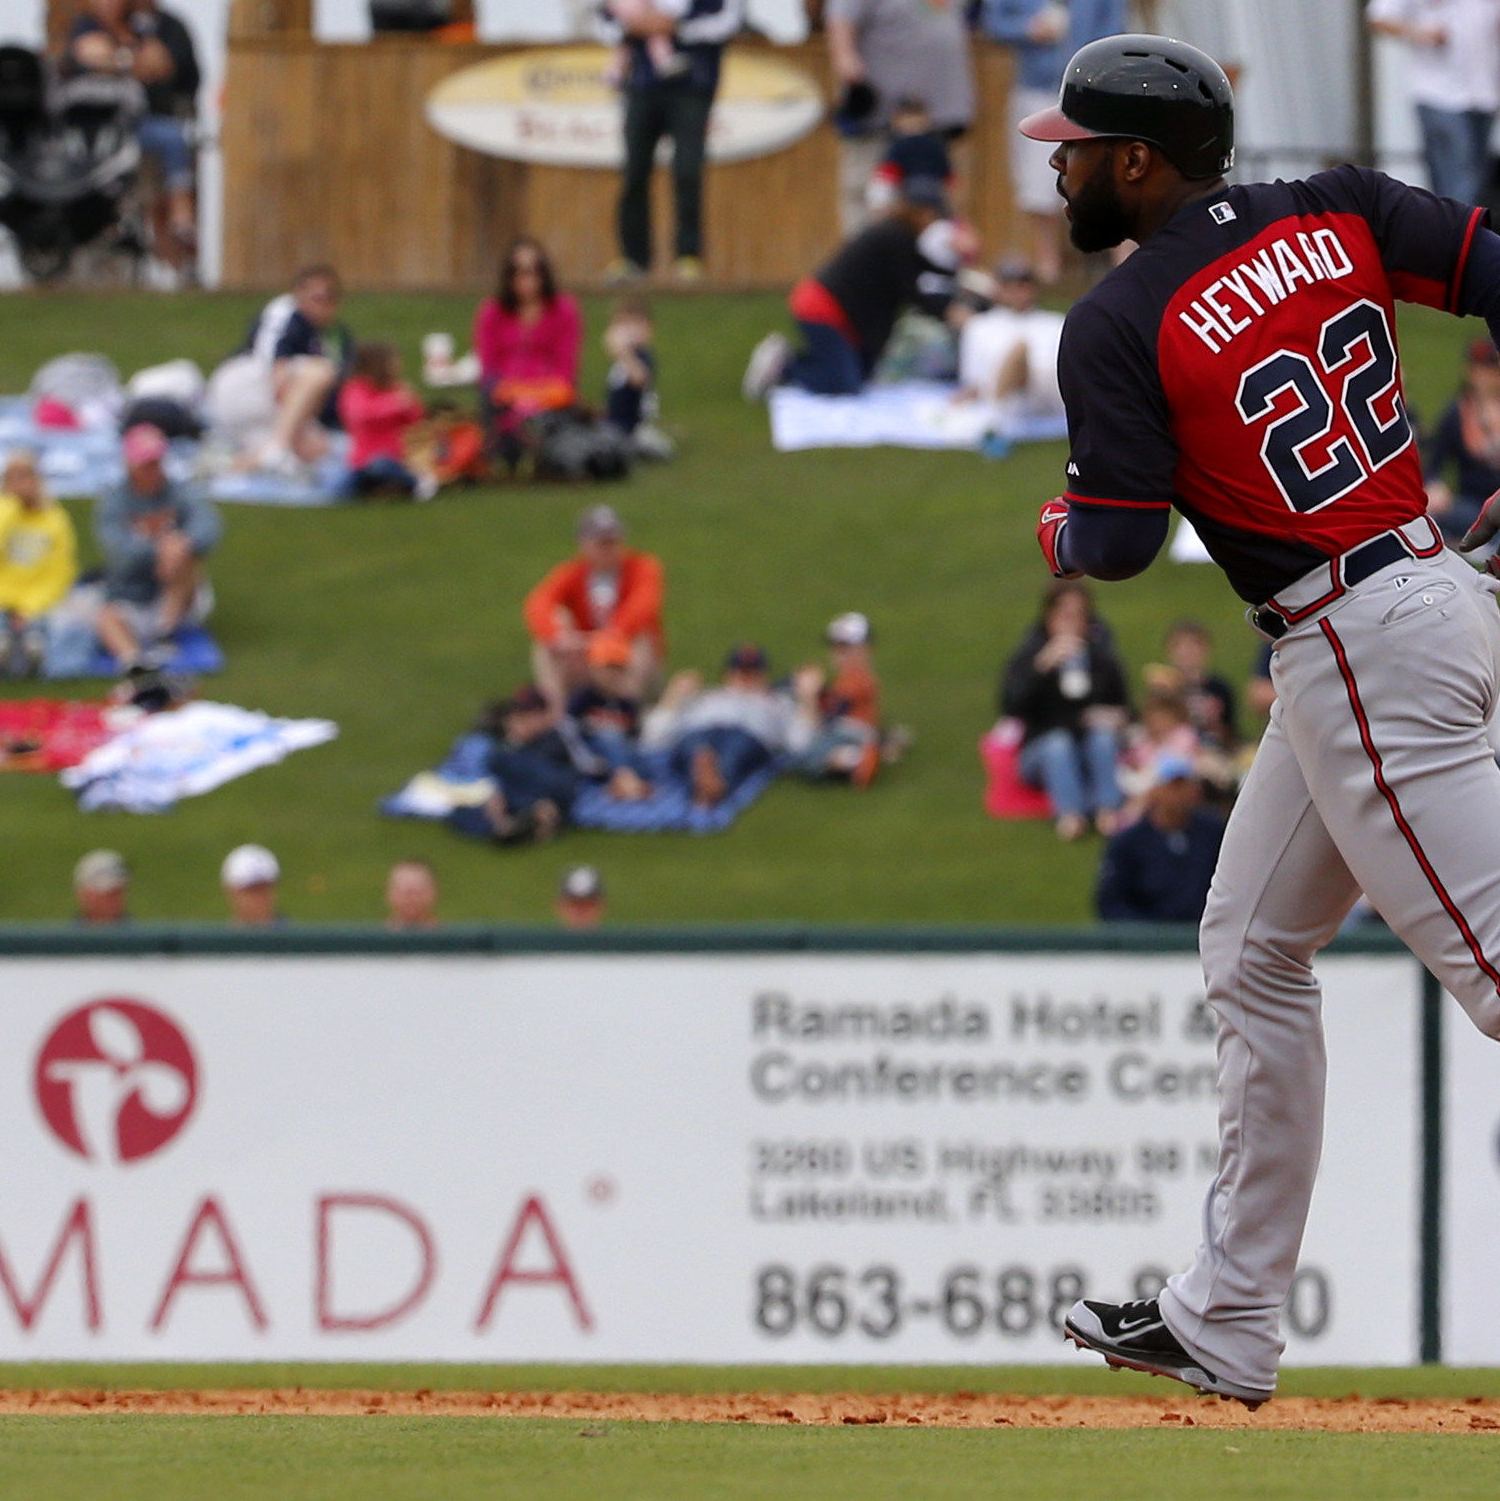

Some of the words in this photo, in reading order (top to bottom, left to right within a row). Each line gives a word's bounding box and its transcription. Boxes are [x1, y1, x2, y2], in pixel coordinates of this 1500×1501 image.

[1178, 228, 1355, 354] HEYWARD
[1234, 298, 1413, 514] 22
[752, 993, 991, 1042] Ramada
[1009, 993, 1161, 1042] Hotel
[750, 1051, 1090, 1103] Conference
[1107, 1051, 1219, 1103] Cen
